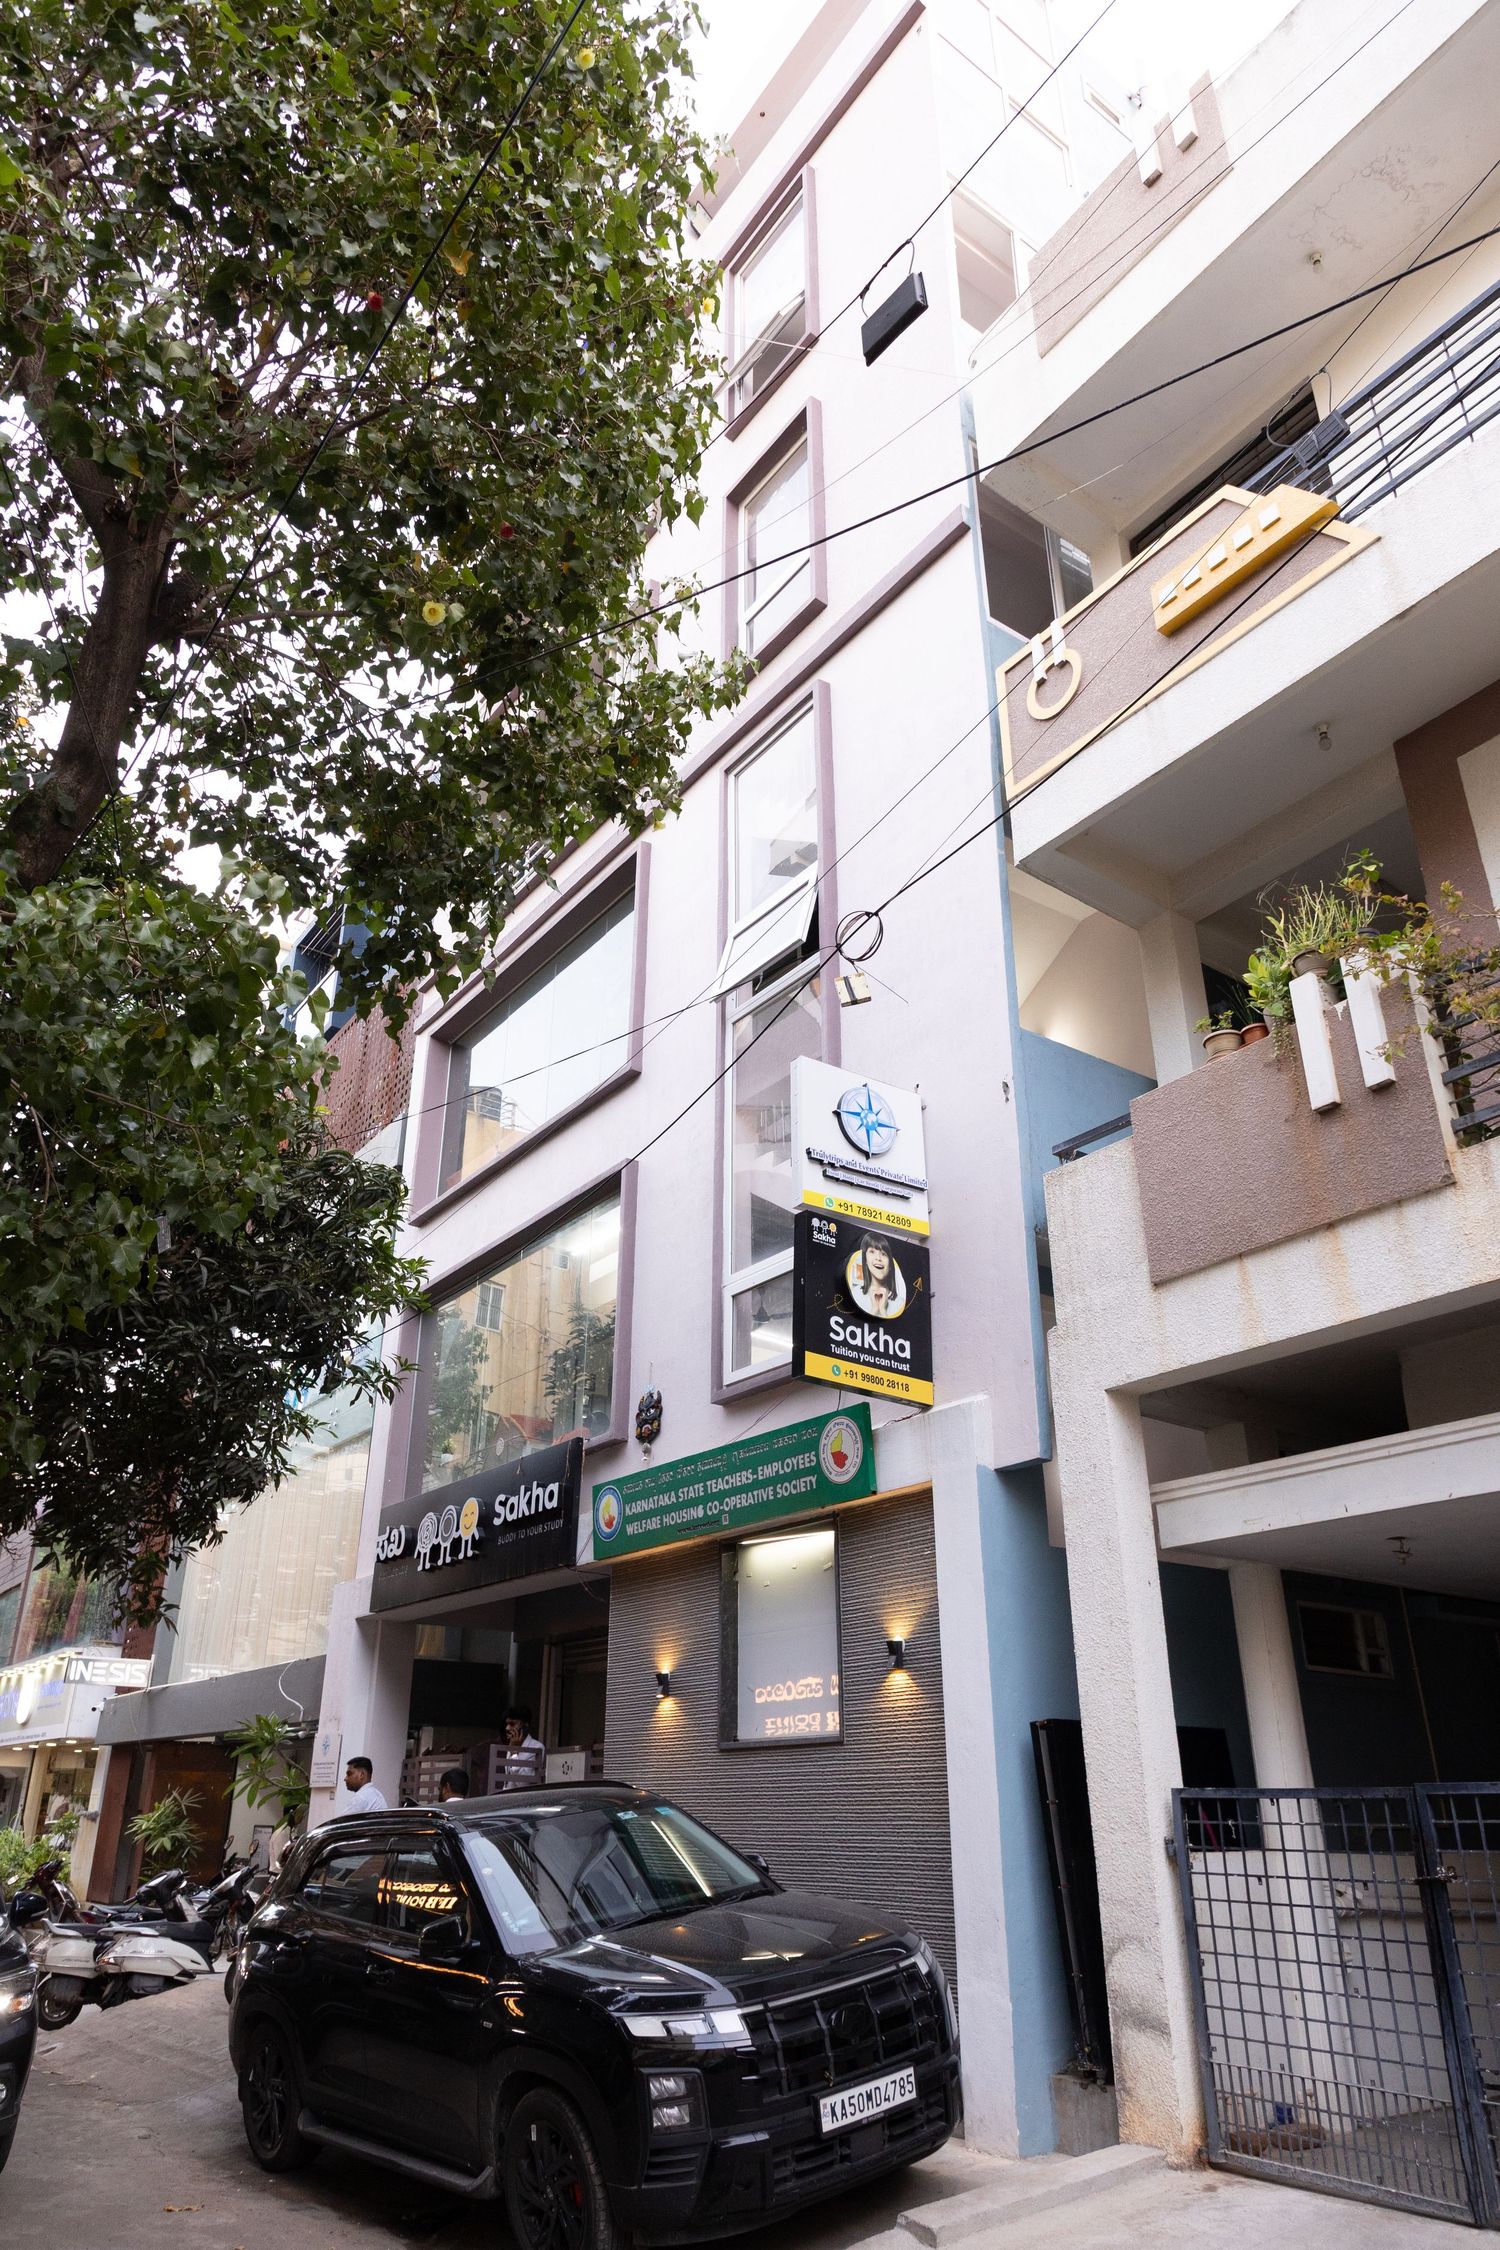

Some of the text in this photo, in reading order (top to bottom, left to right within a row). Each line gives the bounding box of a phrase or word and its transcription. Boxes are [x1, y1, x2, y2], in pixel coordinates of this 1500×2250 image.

[811, 1149, 928, 1188] Trulytrips and Events Private Limited
[838, 1202, 912, 1228] +91 78921 42809
[813, 1231, 836, 1244] Sakha
[829, 1315, 911, 1359] Sakha
[830, 1343, 910, 1372] Tuition you can trust
[843, 1369, 910, 1392] +91 99800 28118
[625, 1491, 677, 1516] KARNATAKA
[678, 1484, 705, 1502] STATE
[706, 1451, 817, 1494] TEACHERS-EMPLOYEES
[493, 1480, 560, 1526] Sakha
[626, 1514, 661, 1536] WELFARE
[663, 1505, 705, 1526] HOUSING
[706, 1486, 774, 1516] CO-OPERATIVE
[776, 1474, 818, 1498] SOCIETY
[497, 1518, 564, 1545] BUDDY TO YOUR STUDY
[69, 1660, 148, 1683] INESIS
[830, 2073, 914, 2123] KA50MD4785
